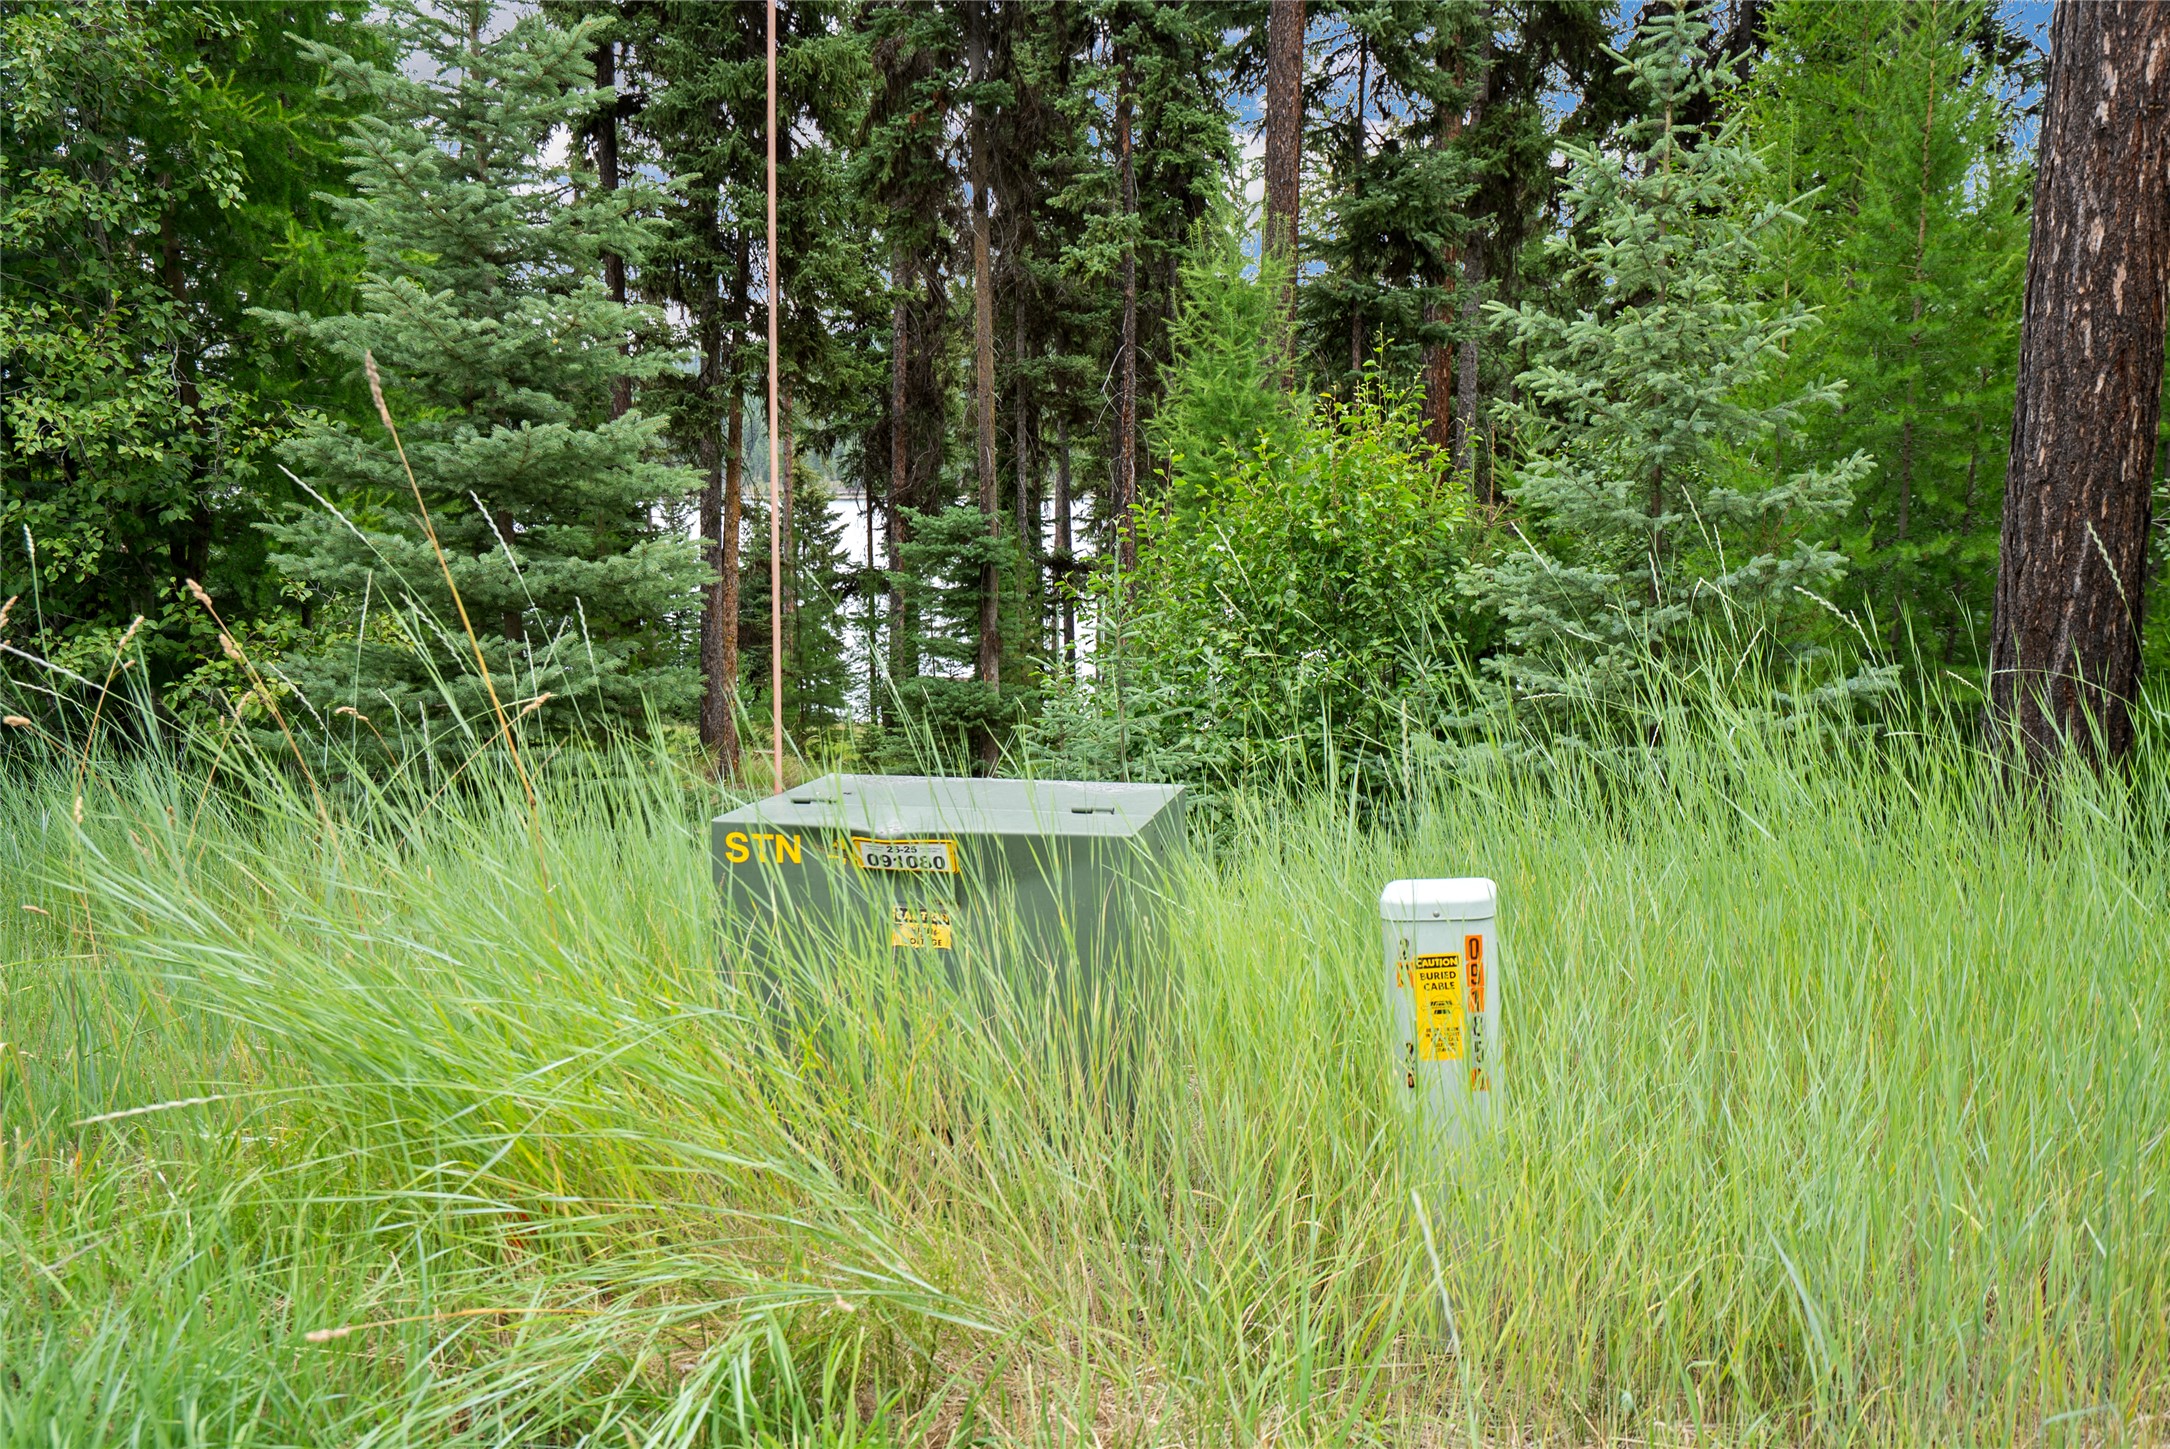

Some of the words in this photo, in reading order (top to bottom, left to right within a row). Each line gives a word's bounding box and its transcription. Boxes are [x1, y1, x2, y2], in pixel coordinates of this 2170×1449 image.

[725, 831, 802, 864] STN
[866, 853, 946, 871] 091080
[1417, 957, 1458, 968] CAUTION
[1420, 971, 1457, 980] BURIED
[1424, 982, 1455, 991] CABLE
